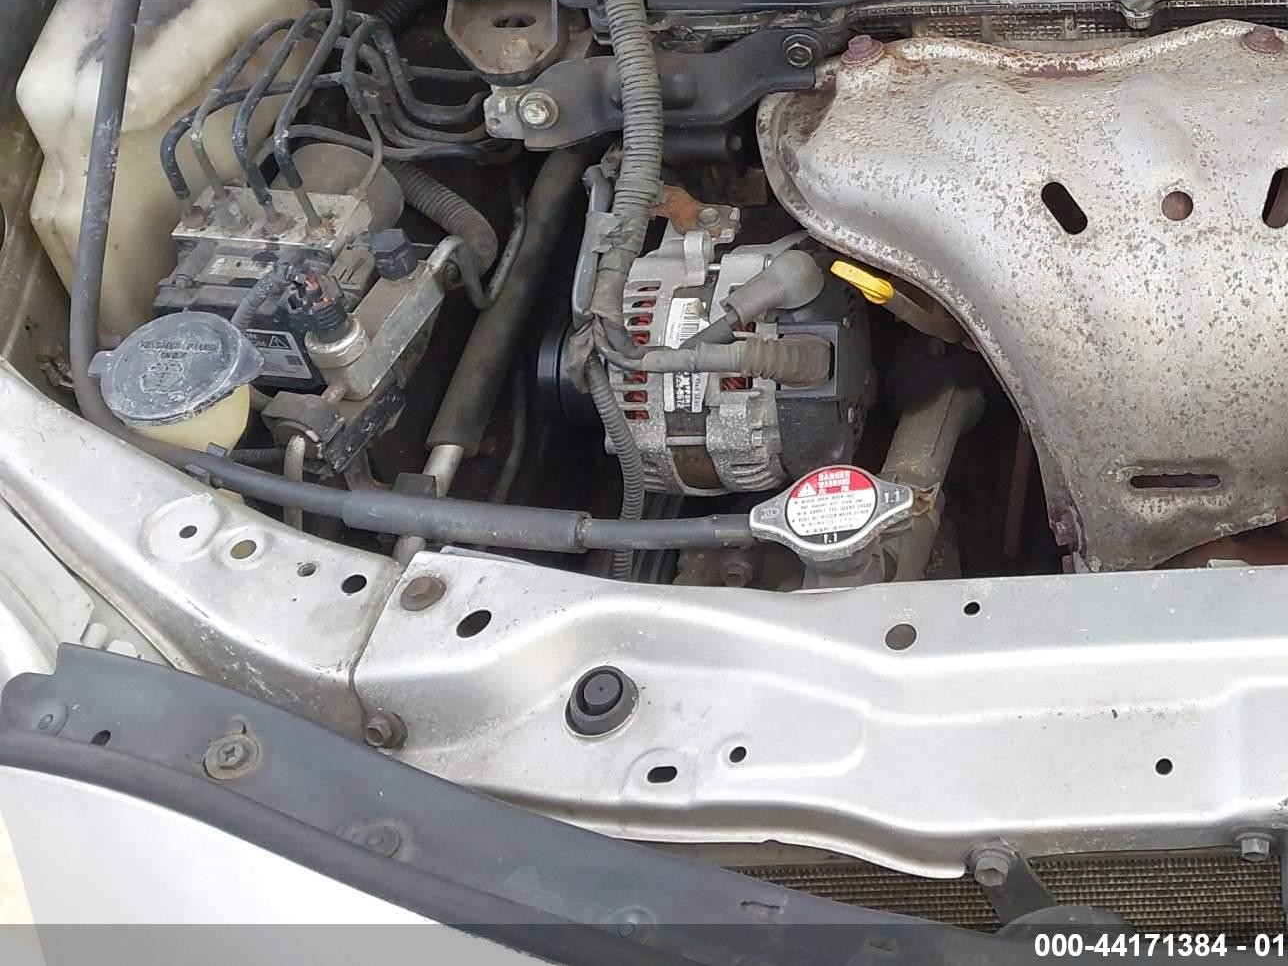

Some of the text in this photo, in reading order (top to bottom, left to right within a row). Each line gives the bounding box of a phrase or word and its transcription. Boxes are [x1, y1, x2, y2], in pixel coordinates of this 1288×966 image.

[139, 340, 218, 351] WASHER FLUID
[160, 350, 187, 360] ONLY
[818, 470, 850, 482] DANGER
[823, 532, 838, 544] 1.1
